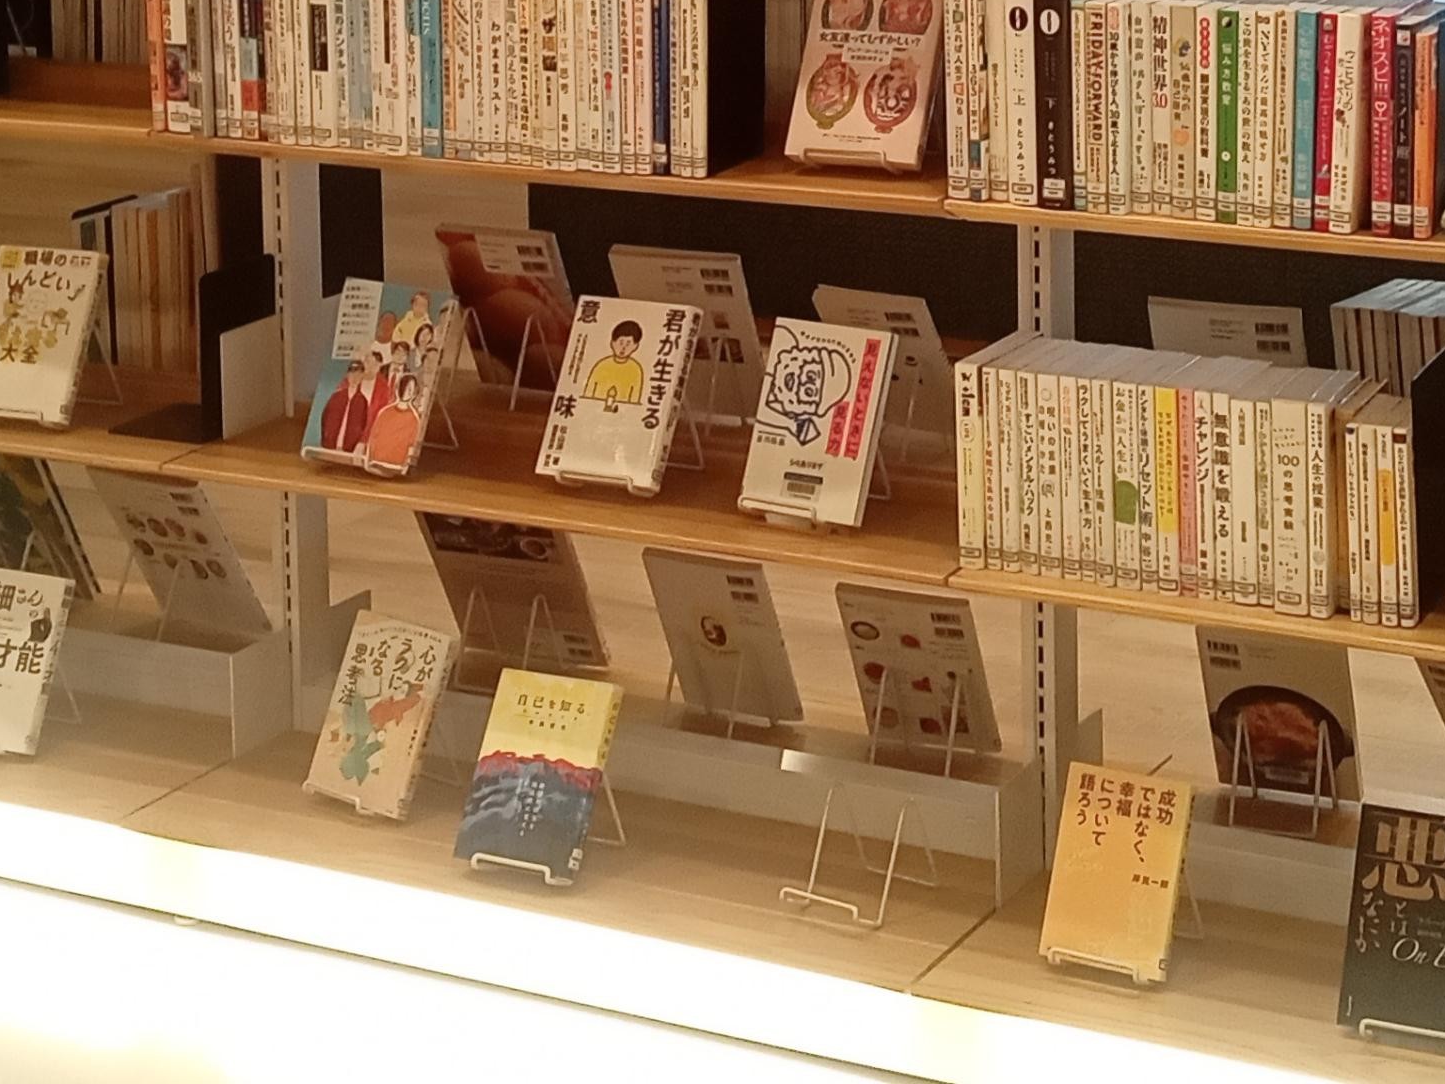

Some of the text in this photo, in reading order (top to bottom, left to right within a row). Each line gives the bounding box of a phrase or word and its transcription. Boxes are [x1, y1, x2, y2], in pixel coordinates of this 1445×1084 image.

[0, 343, 40, 365] 大全
[640, 308, 687, 430] 君が生きる
[843, 337, 882, 460] 見えないときに
[1213, 412, 1231, 538] 無意識を鍛える
[1276, 453, 1301, 467] 100
[338, 643, 368, 707] 思考法
[373, 638, 392, 677] なる
[387, 637, 416, 691] ラクに
[414, 644, 438, 683] 心が
[516, 693, 587, 717] 自己を知る
[1076, 772, 1097, 826] 語ろう
[1091, 777, 1115, 847] について
[1116, 781, 1136, 818] 幸福
[1155, 789, 1178, 826] 成功
[1132, 786, 1156, 863] ではなく、
[1391, 937, 1429, 965] On
